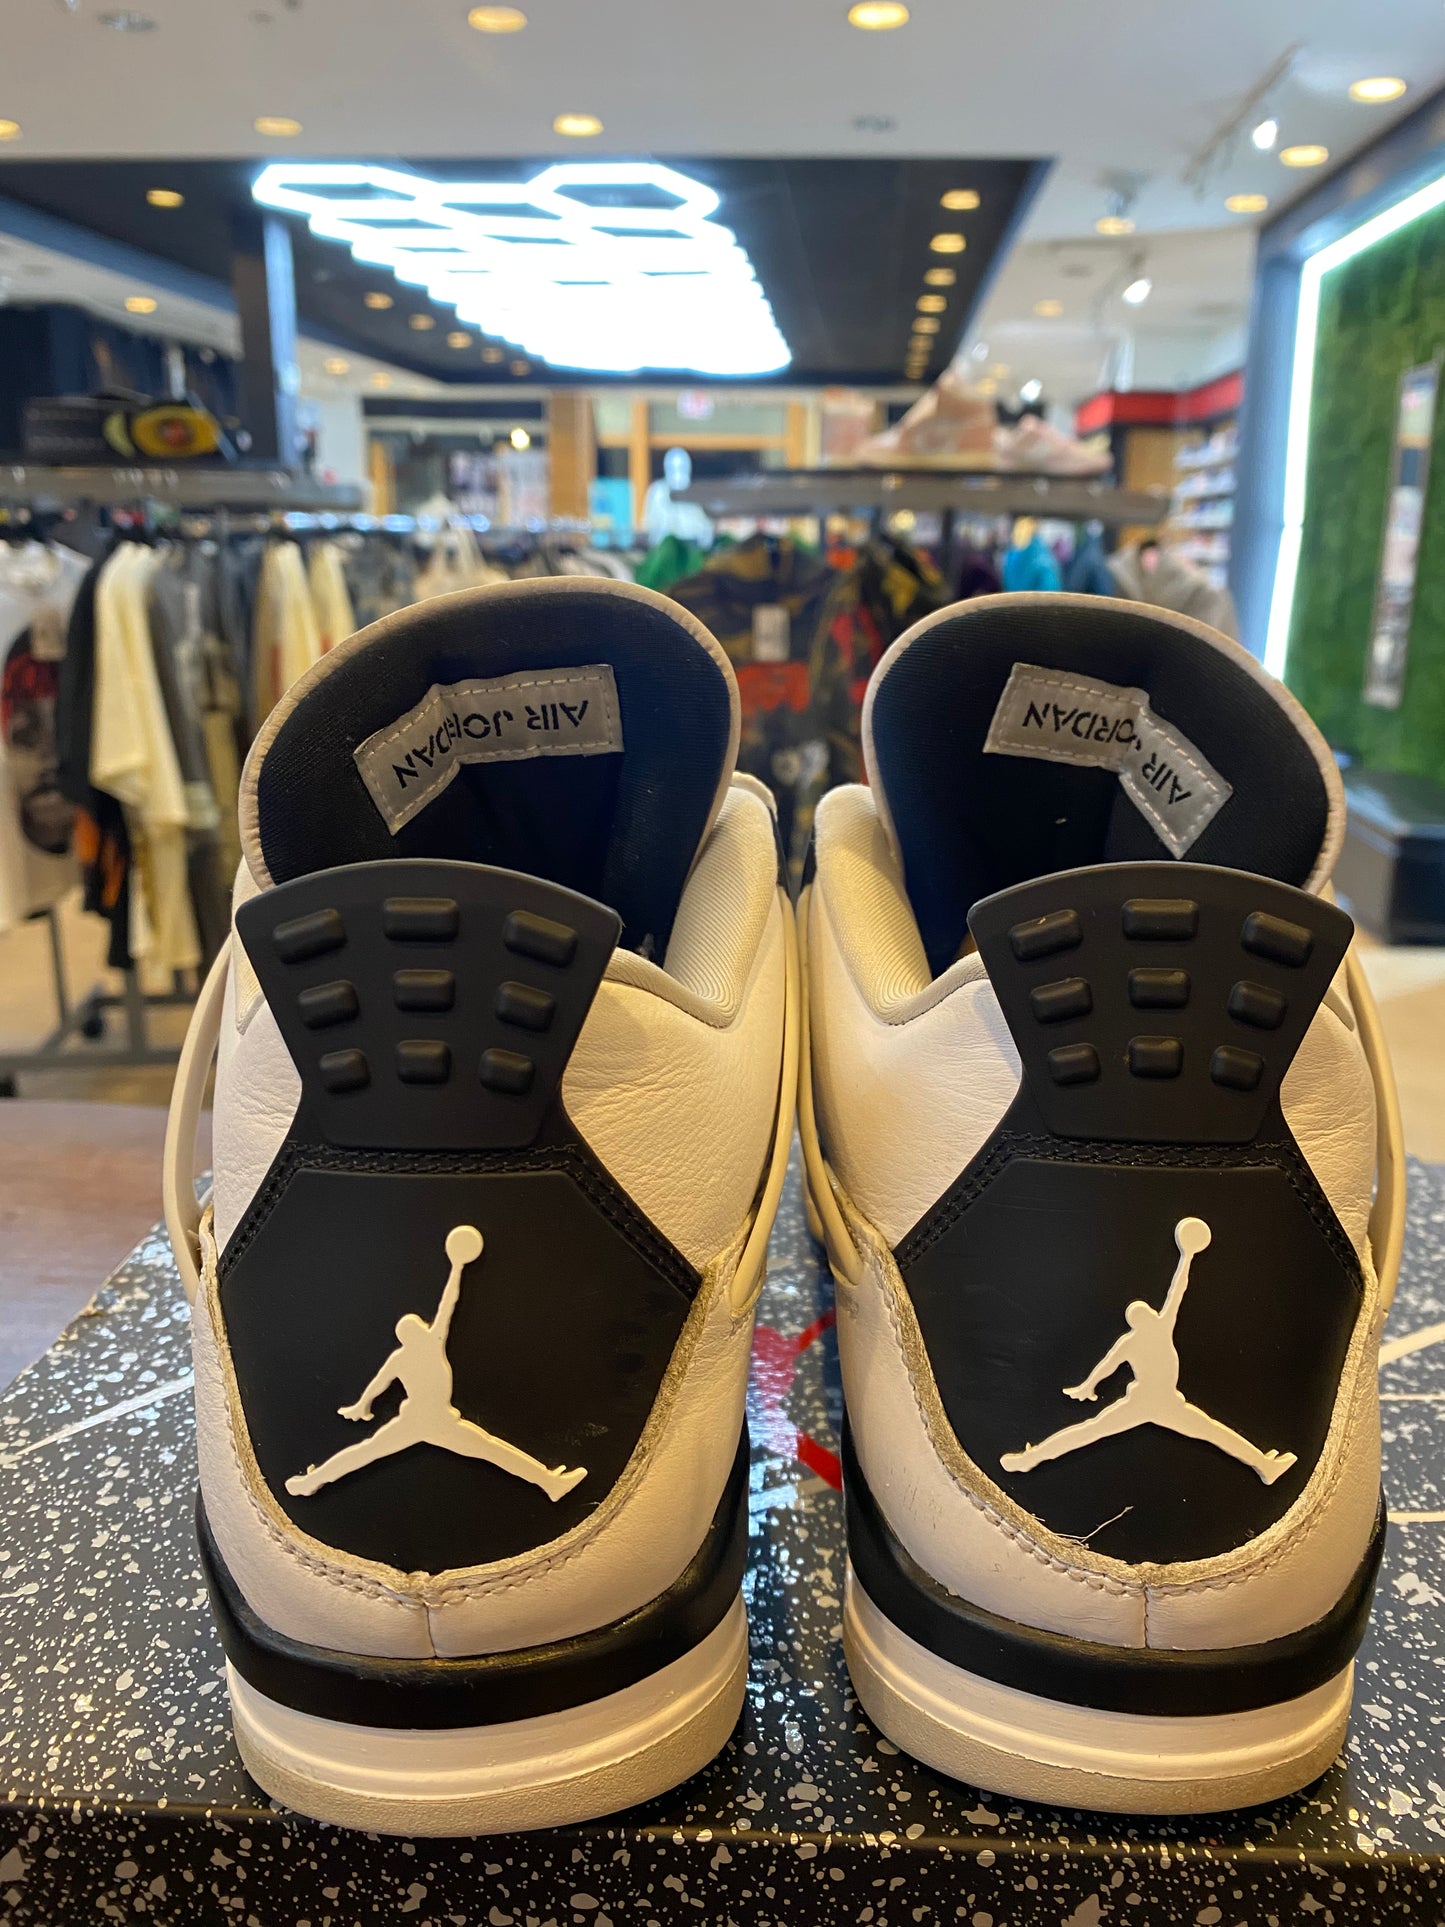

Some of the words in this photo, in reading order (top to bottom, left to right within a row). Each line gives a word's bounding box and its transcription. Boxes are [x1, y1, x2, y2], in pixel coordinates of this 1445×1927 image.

[524, 700, 589, 730] AIR
[1022, 701, 1142, 751] ORDAN
[1141, 752, 1192, 805] AIR
